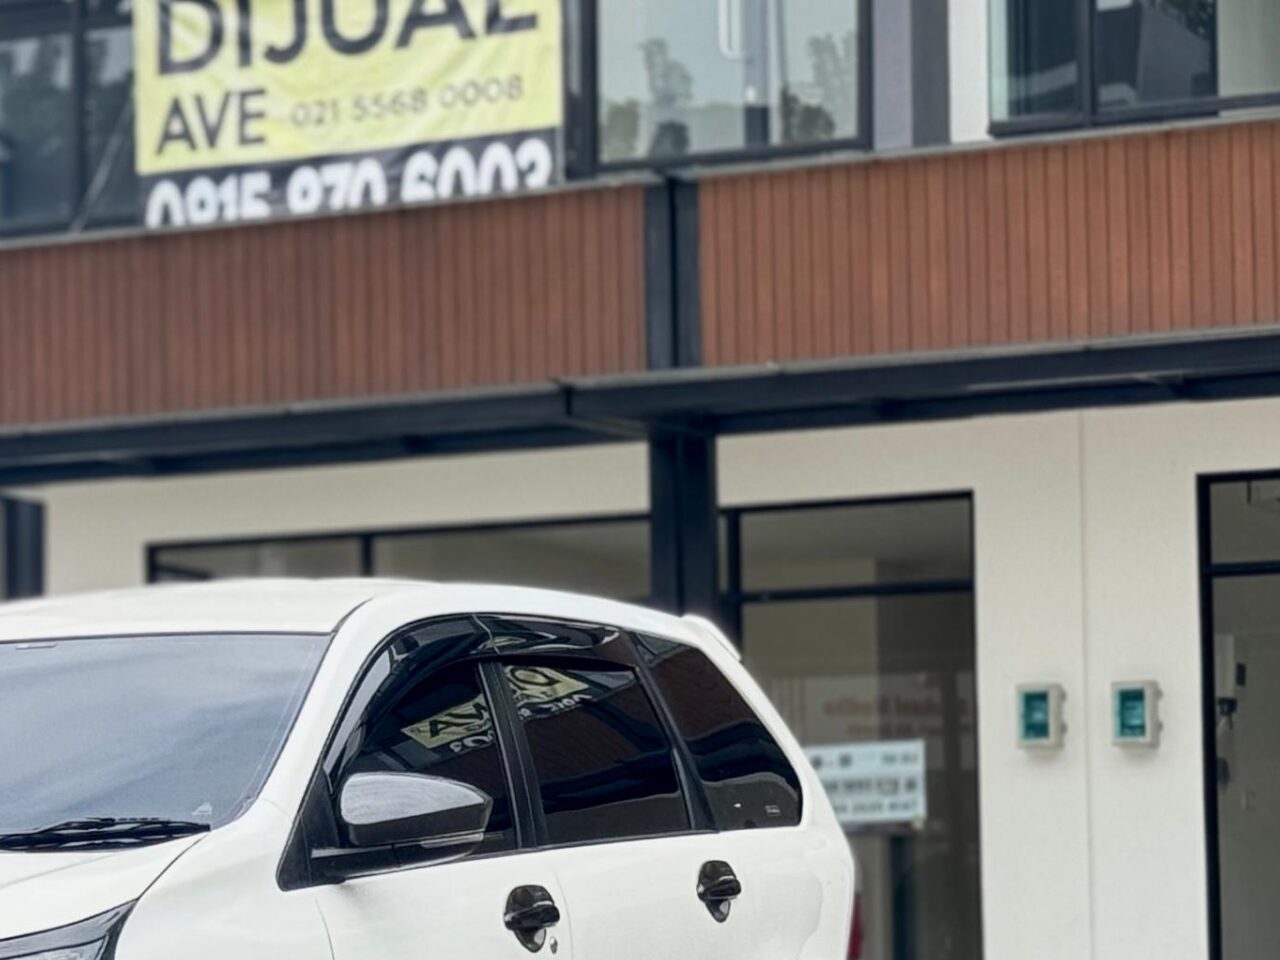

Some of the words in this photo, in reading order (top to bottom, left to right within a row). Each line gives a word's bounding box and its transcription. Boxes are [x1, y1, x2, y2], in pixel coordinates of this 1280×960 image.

[155, 87, 267, 156] AVE
[290, 98, 341, 127] 021
[438, 74, 524, 109] 0008
